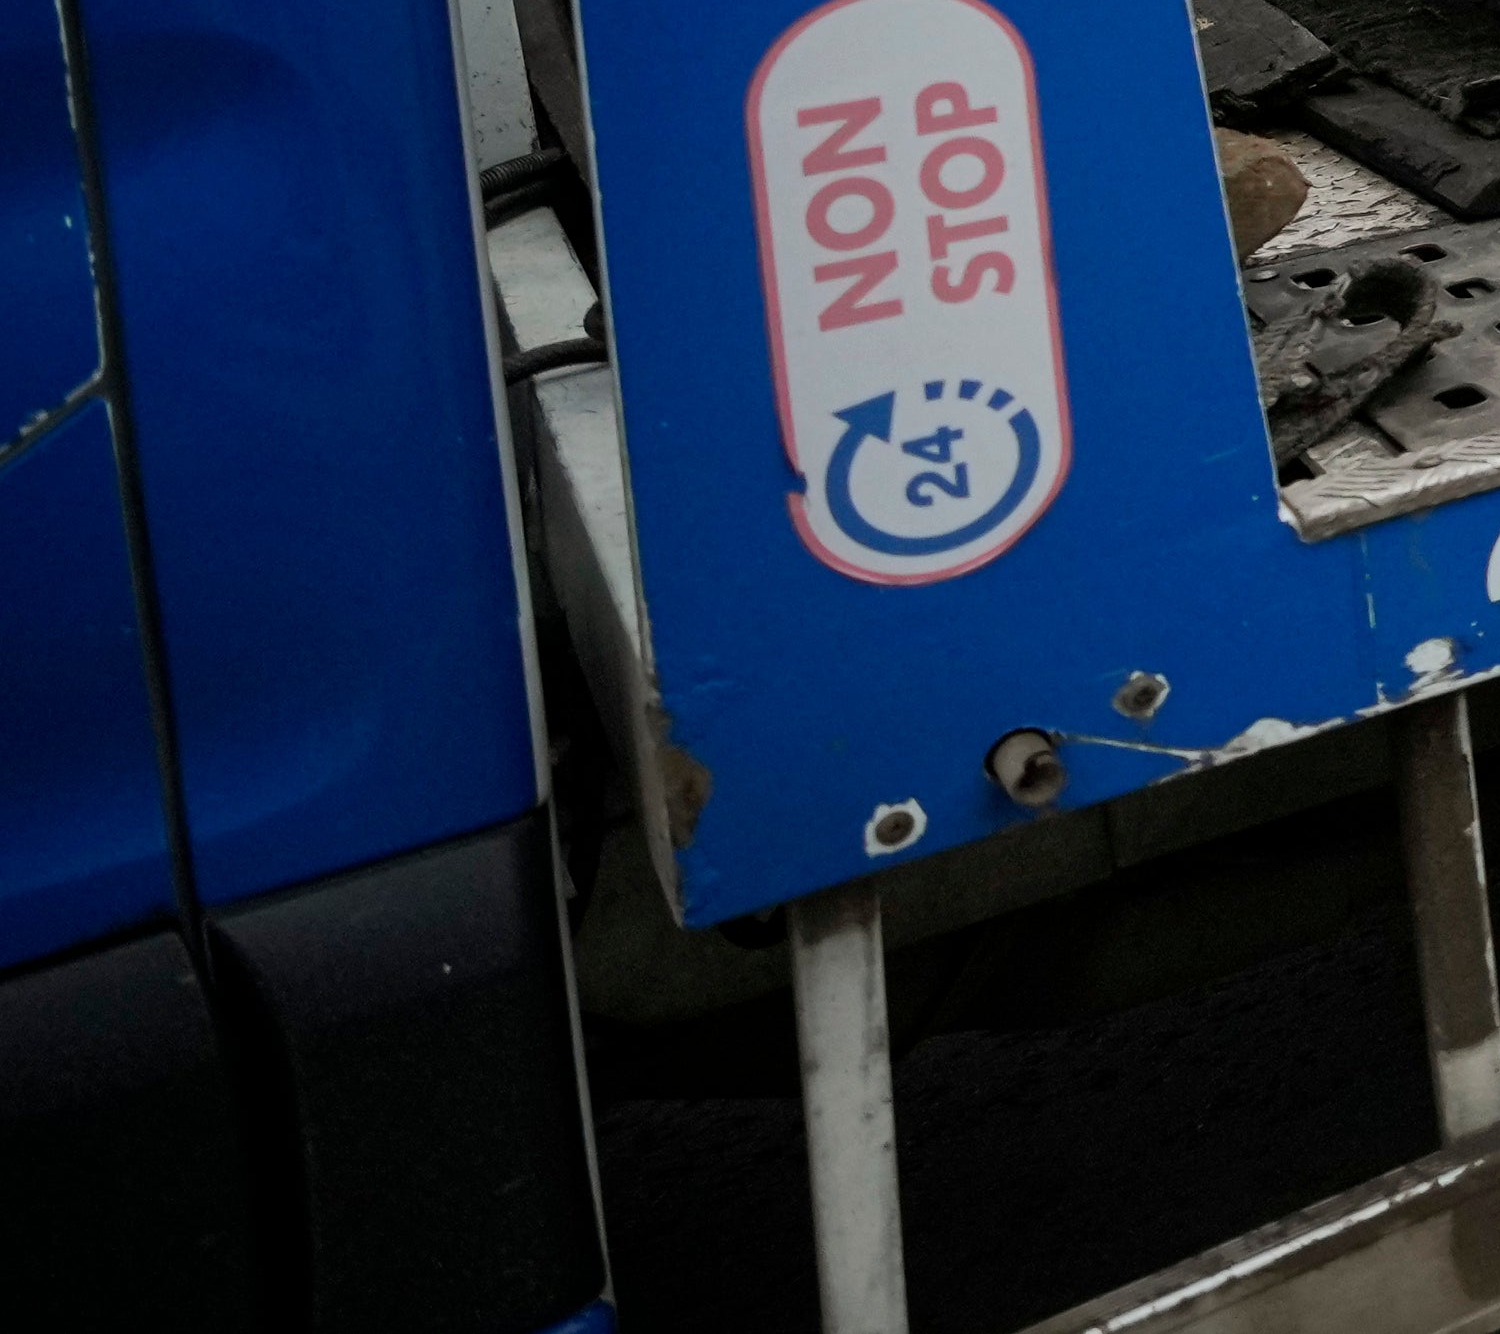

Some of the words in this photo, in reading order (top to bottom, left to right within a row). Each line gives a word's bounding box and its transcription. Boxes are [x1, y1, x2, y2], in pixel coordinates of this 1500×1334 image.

[796, 96, 905, 333] NON
[914, 80, 1015, 304] STOP
[900, 424, 970, 507] 24
